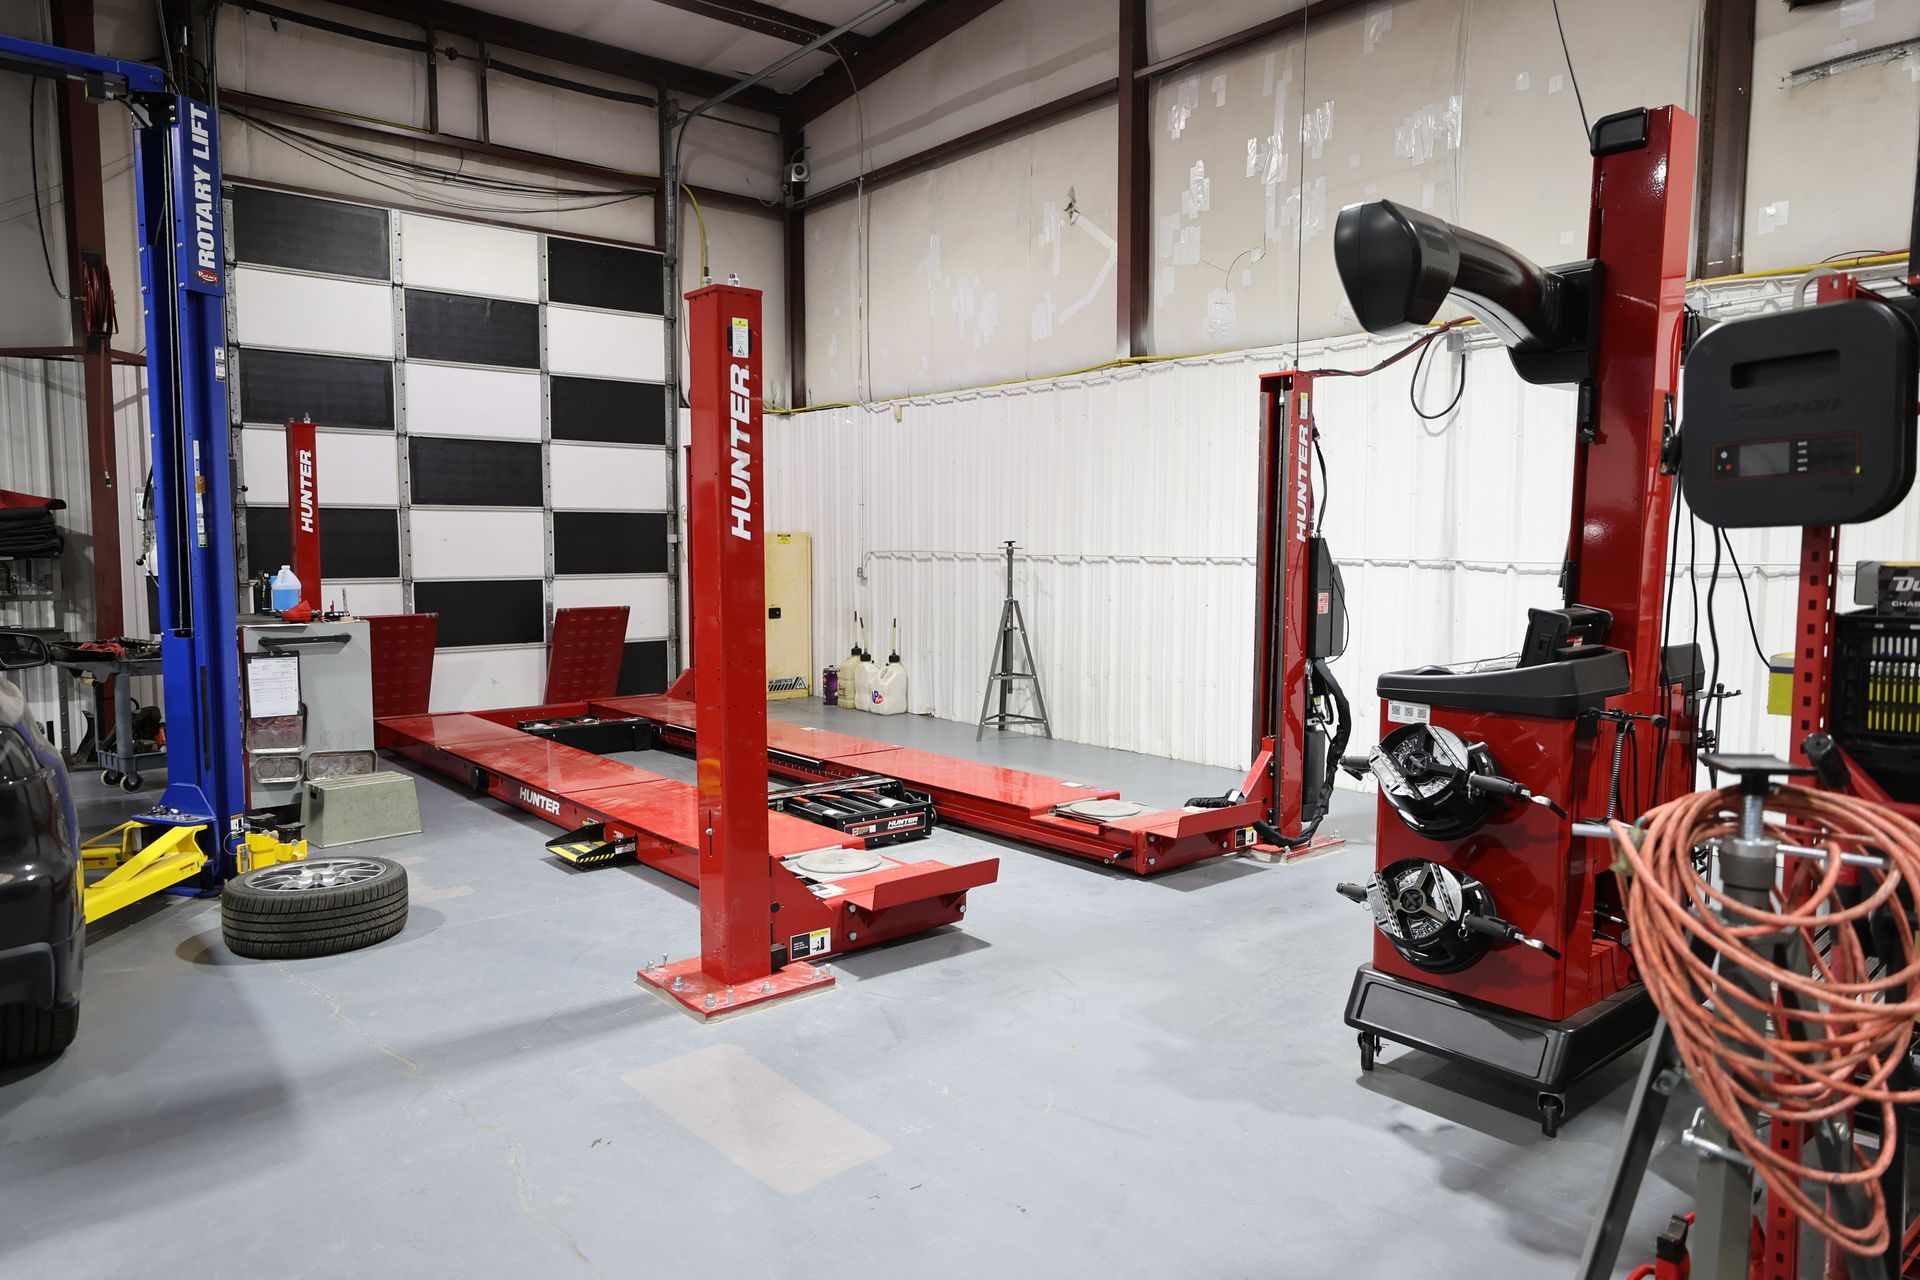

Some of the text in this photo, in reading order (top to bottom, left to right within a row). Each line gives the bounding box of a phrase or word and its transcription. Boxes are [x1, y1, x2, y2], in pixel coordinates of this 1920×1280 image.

[189, 102, 216, 269] ROTARY LIFT
[299, 449, 314, 533] HUNTER
[730, 363, 751, 540] HUNTER
[1296, 424, 1309, 543] HUNTER
[519, 786, 560, 816] HUNTER
[887, 816, 919, 827] HUNTER
